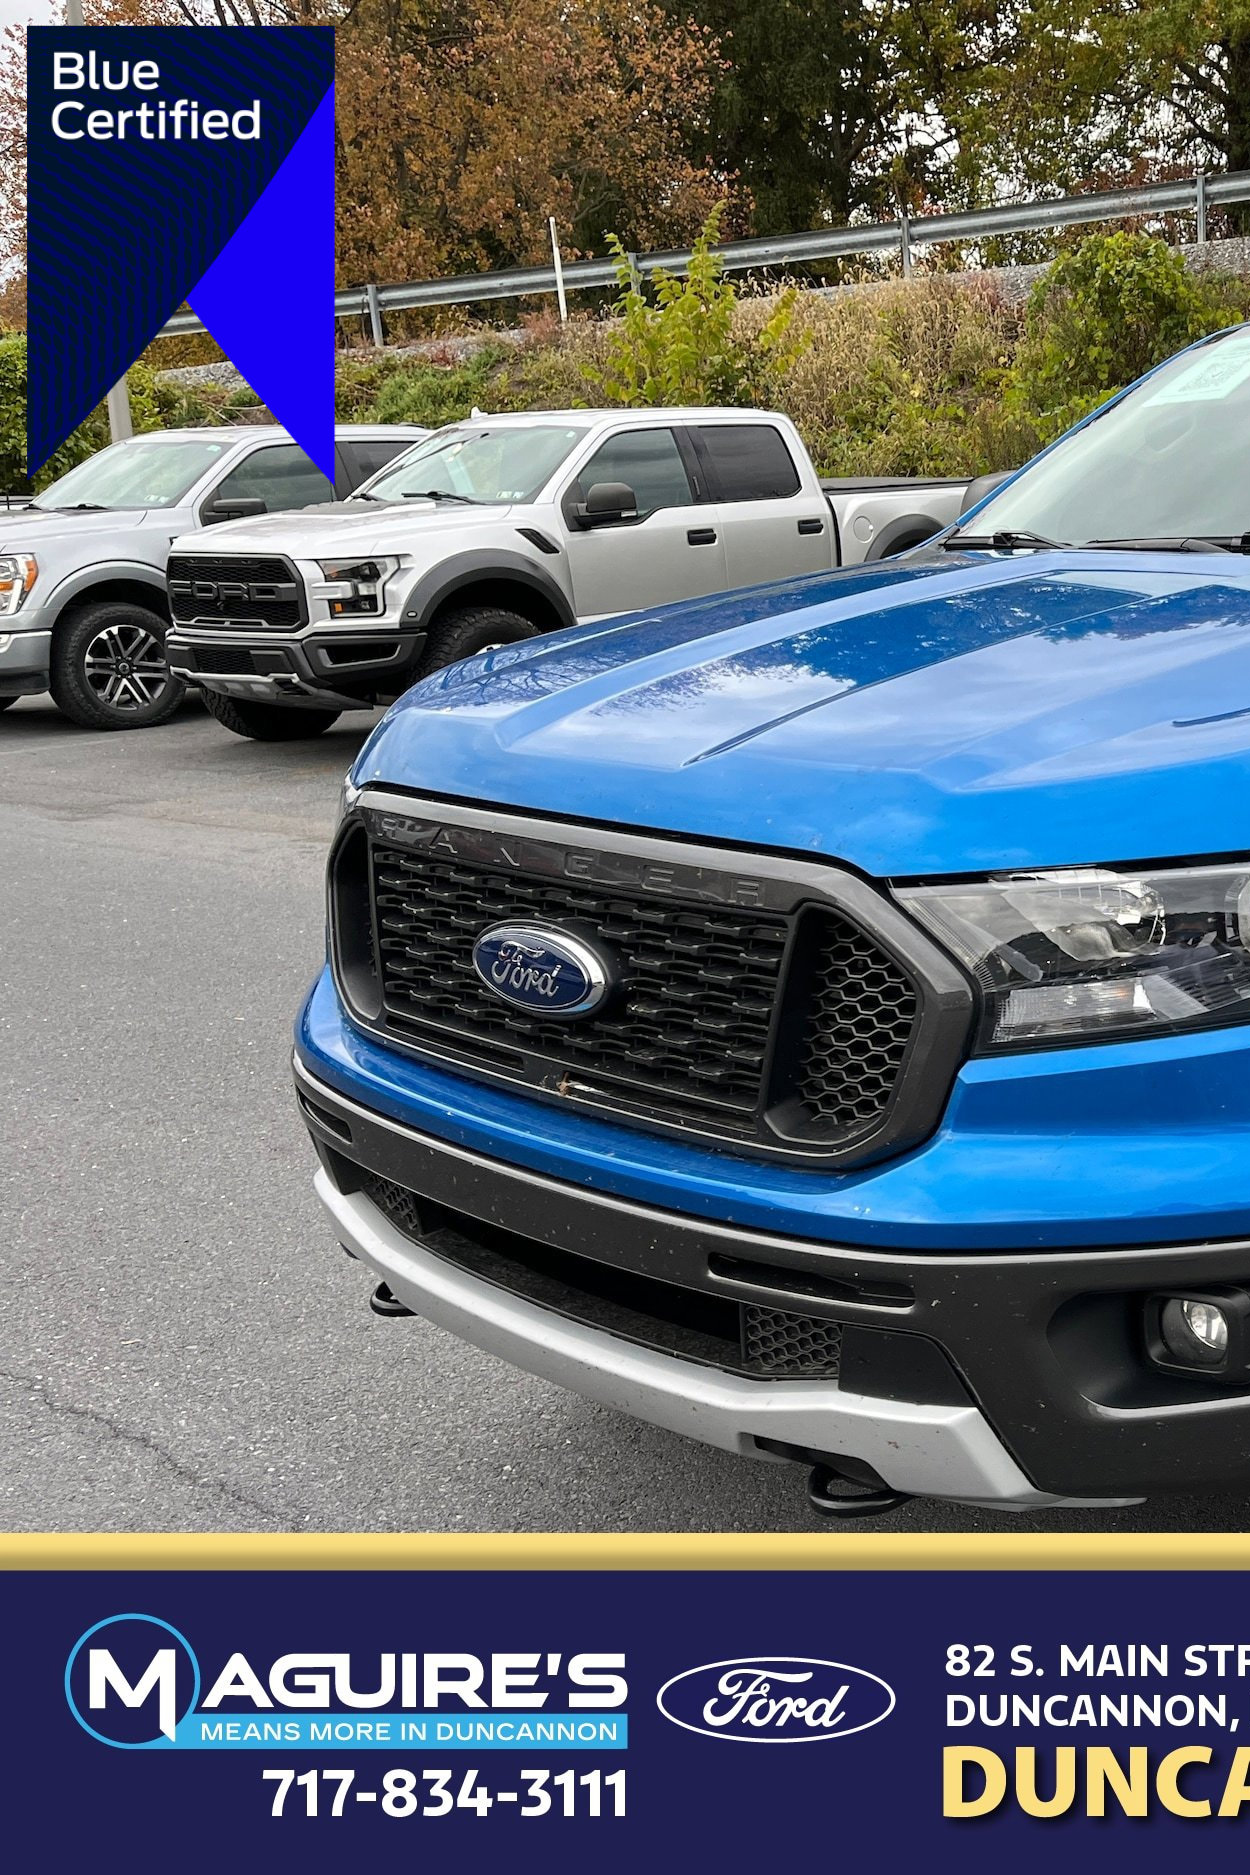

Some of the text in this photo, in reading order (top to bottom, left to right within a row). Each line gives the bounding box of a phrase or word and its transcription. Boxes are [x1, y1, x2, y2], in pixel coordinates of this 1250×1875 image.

[169, 580, 278, 602] FORD
[377, 816, 766, 907] RANGER
[491, 941, 562, 997] Ford
